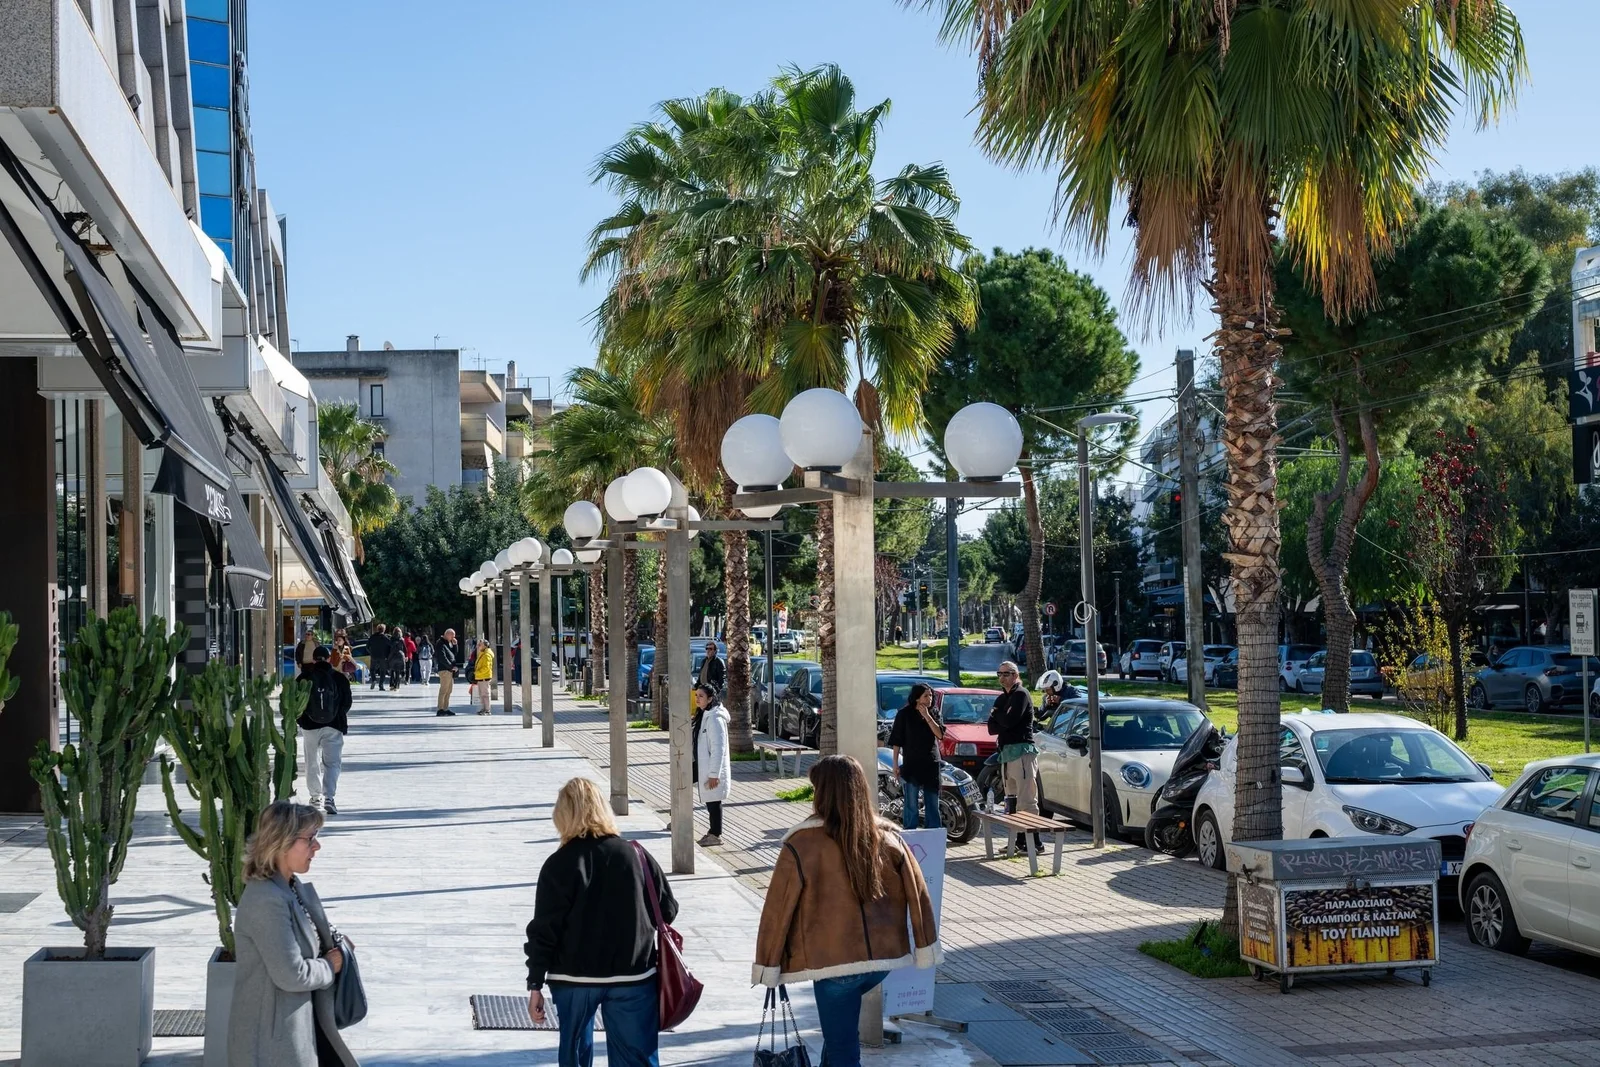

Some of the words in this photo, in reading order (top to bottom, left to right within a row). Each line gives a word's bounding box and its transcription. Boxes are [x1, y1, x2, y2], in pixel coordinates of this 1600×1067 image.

[1325, 898, 1393, 910] ΠΑΡΑΔΟΣΙΑΚΟ
[1302, 913, 1361, 925] ΚΑΛΑΜΠΟΚΙ
[1363, 912, 1371, 922] &
[1373, 910, 1417, 921] ΚΑΣΤΑΝΑ
[1320, 928, 1347, 940] ΤΟΥ
[1351, 925, 1400, 939] ΓΙΑΝΝΗ
